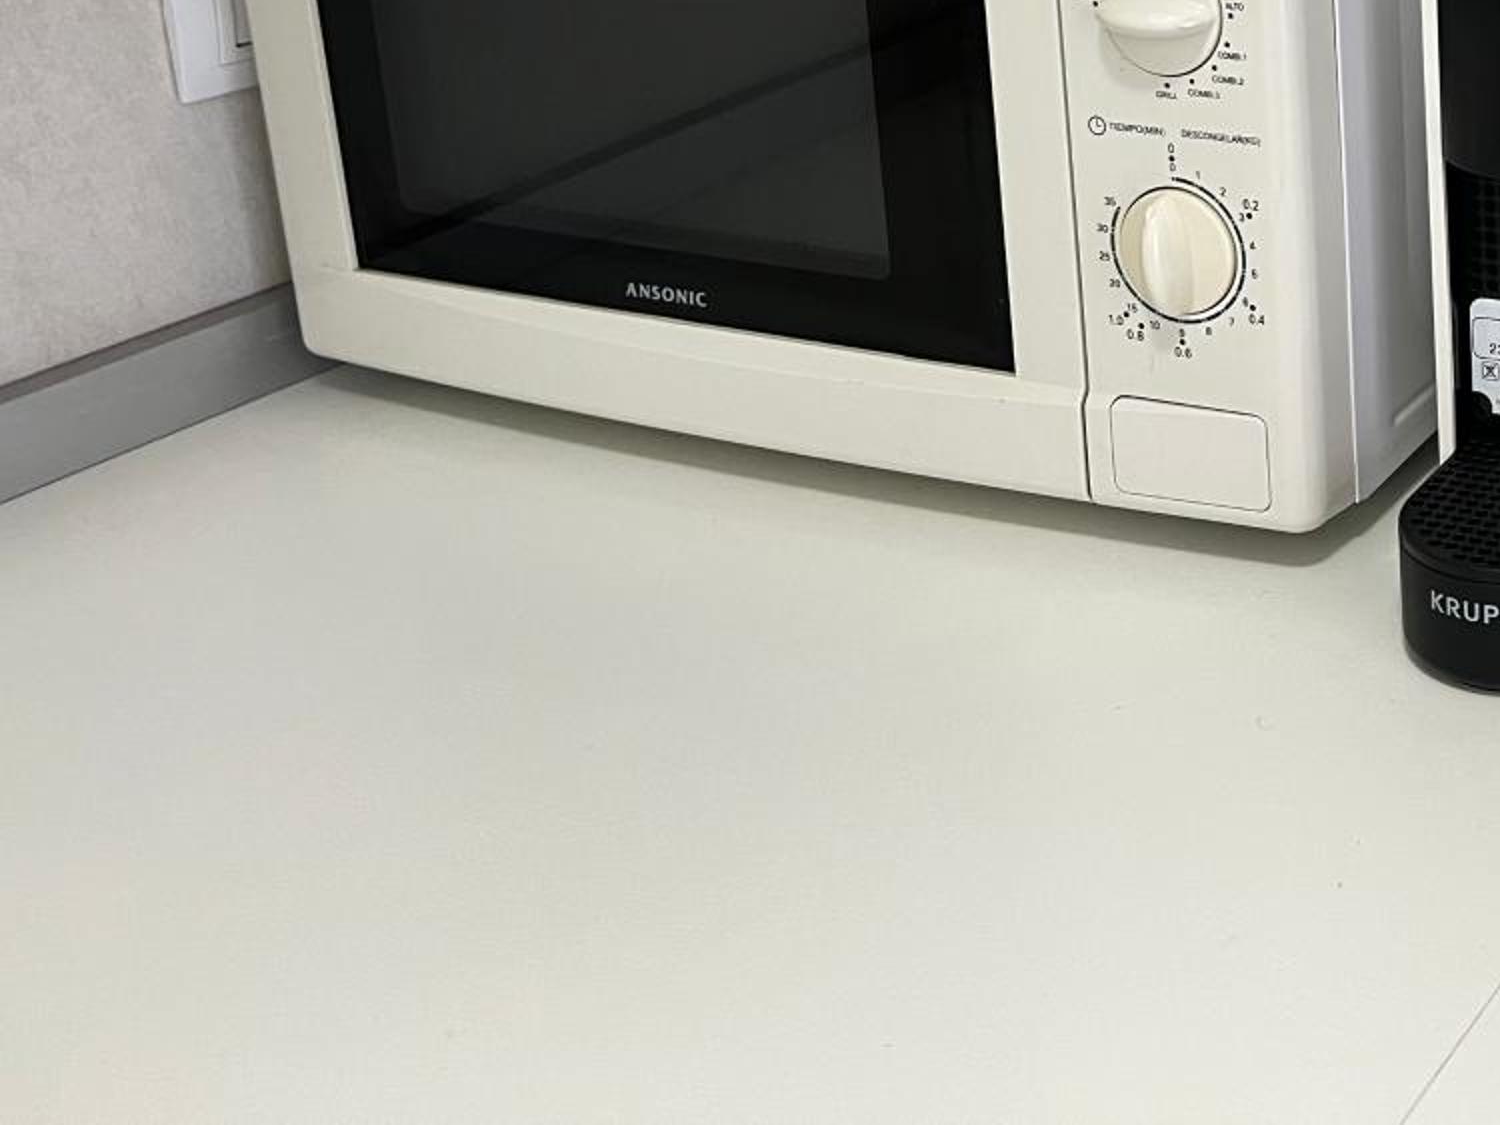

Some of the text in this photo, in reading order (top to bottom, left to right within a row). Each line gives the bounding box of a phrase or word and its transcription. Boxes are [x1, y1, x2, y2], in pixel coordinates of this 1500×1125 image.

[1167, 142, 1175, 154] 0
[1219, 186, 1227, 198] 2
[1242, 198, 1260, 212] 0.2
[1099, 251, 1111, 262] 25
[625, 282, 708, 308] ANSONIC
[1108, 313, 1125, 327] 1.0
[1150, 320, 1161, 331] 10
[1248, 314, 1266, 326] 0.4
[1126, 329, 1145, 342] 0.8
[1174, 346, 1193, 359] 0.6
